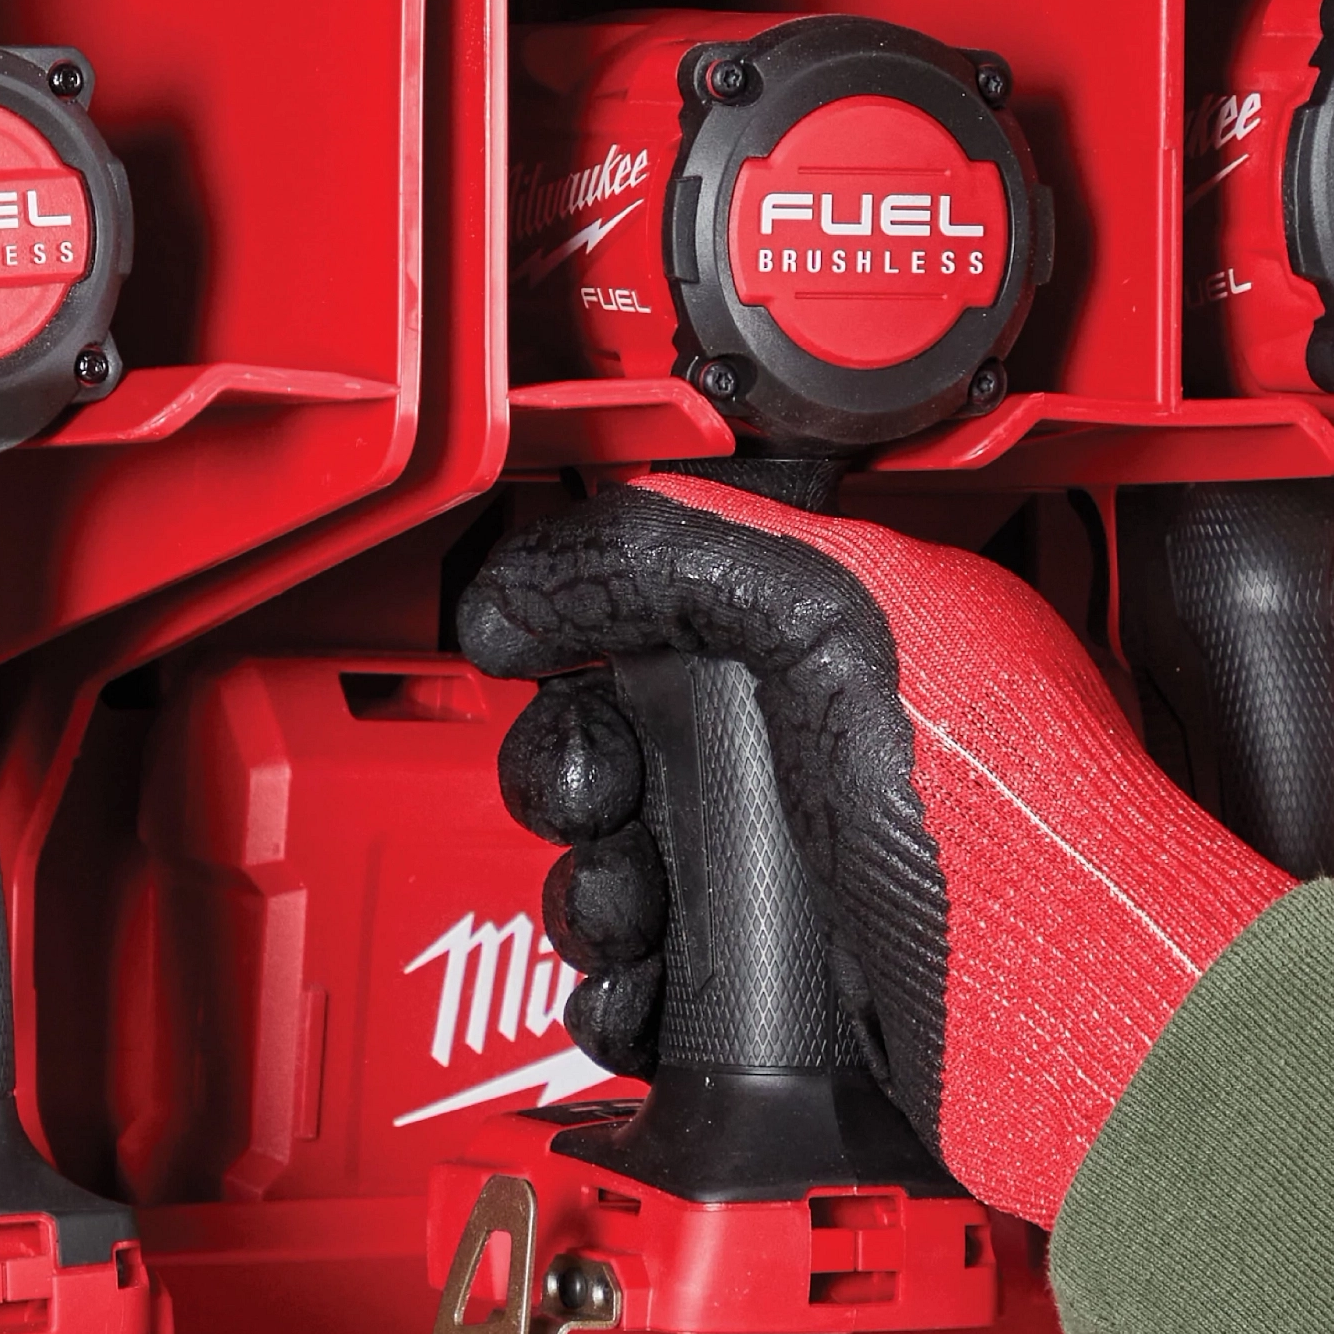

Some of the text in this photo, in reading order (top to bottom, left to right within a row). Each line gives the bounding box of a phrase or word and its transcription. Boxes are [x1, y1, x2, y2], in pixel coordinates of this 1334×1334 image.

[759, 192, 985, 238] FUEL
[758, 249, 985, 276] BRUSHLESS
[579, 285, 653, 315] FUEL
